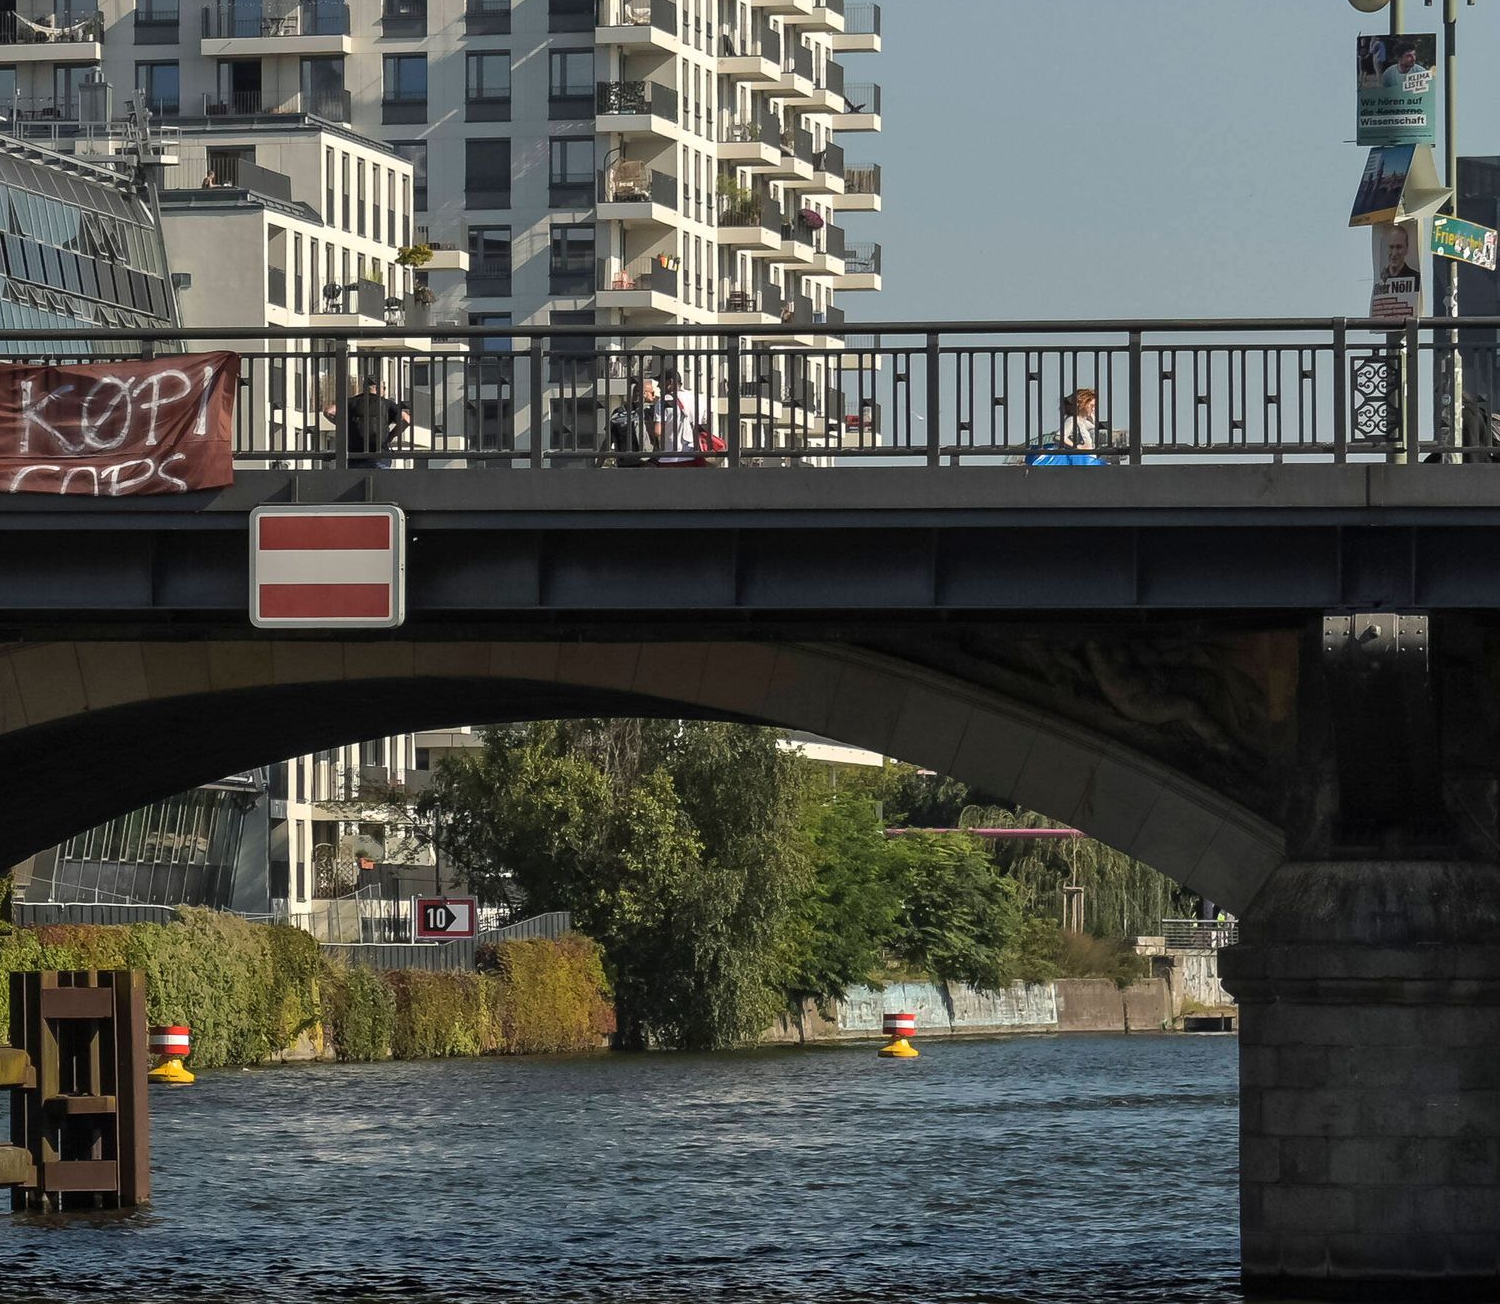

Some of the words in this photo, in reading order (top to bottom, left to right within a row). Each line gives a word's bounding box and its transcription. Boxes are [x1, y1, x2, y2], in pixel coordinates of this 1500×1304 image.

[1408, 73, 1430, 82] KLIMA
[1404, 80, 1424, 89] LISTE
[1361, 98, 1375, 106] Wir
[1377, 97, 1404, 106] hören
[1407, 96, 1422, 105] auf
[1360, 117, 1425, 126] Wissenschaft
[1392, 280, 1413, 294] Nöll
[426, 908, 446, 928] 10
